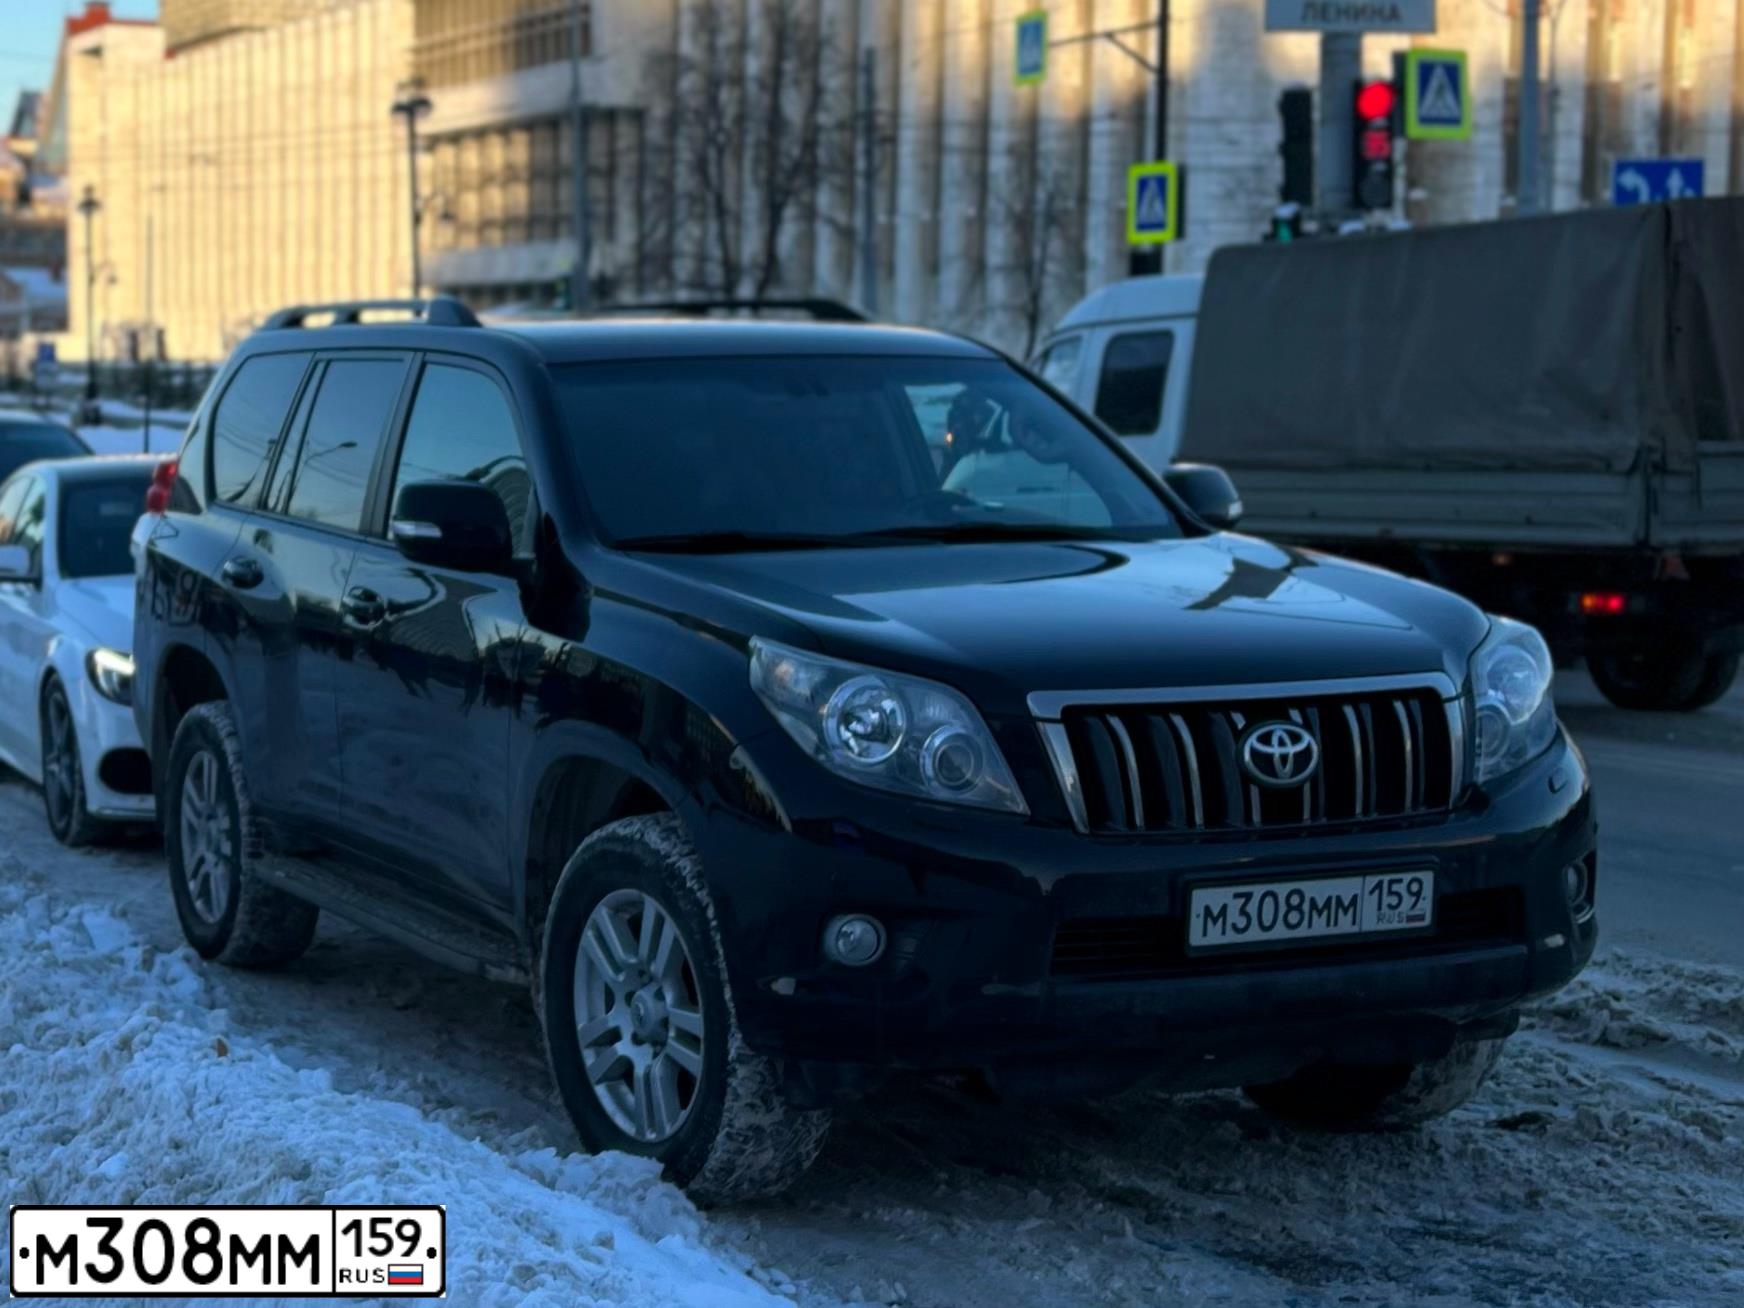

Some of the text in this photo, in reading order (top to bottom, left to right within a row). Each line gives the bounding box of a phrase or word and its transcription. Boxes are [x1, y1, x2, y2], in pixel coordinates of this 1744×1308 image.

[1302, 2, 1401, 22] ЛЕНИНА
[1202, 877, 1424, 937] М308ММ 159
[1377, 911, 1404, 925] RUS
